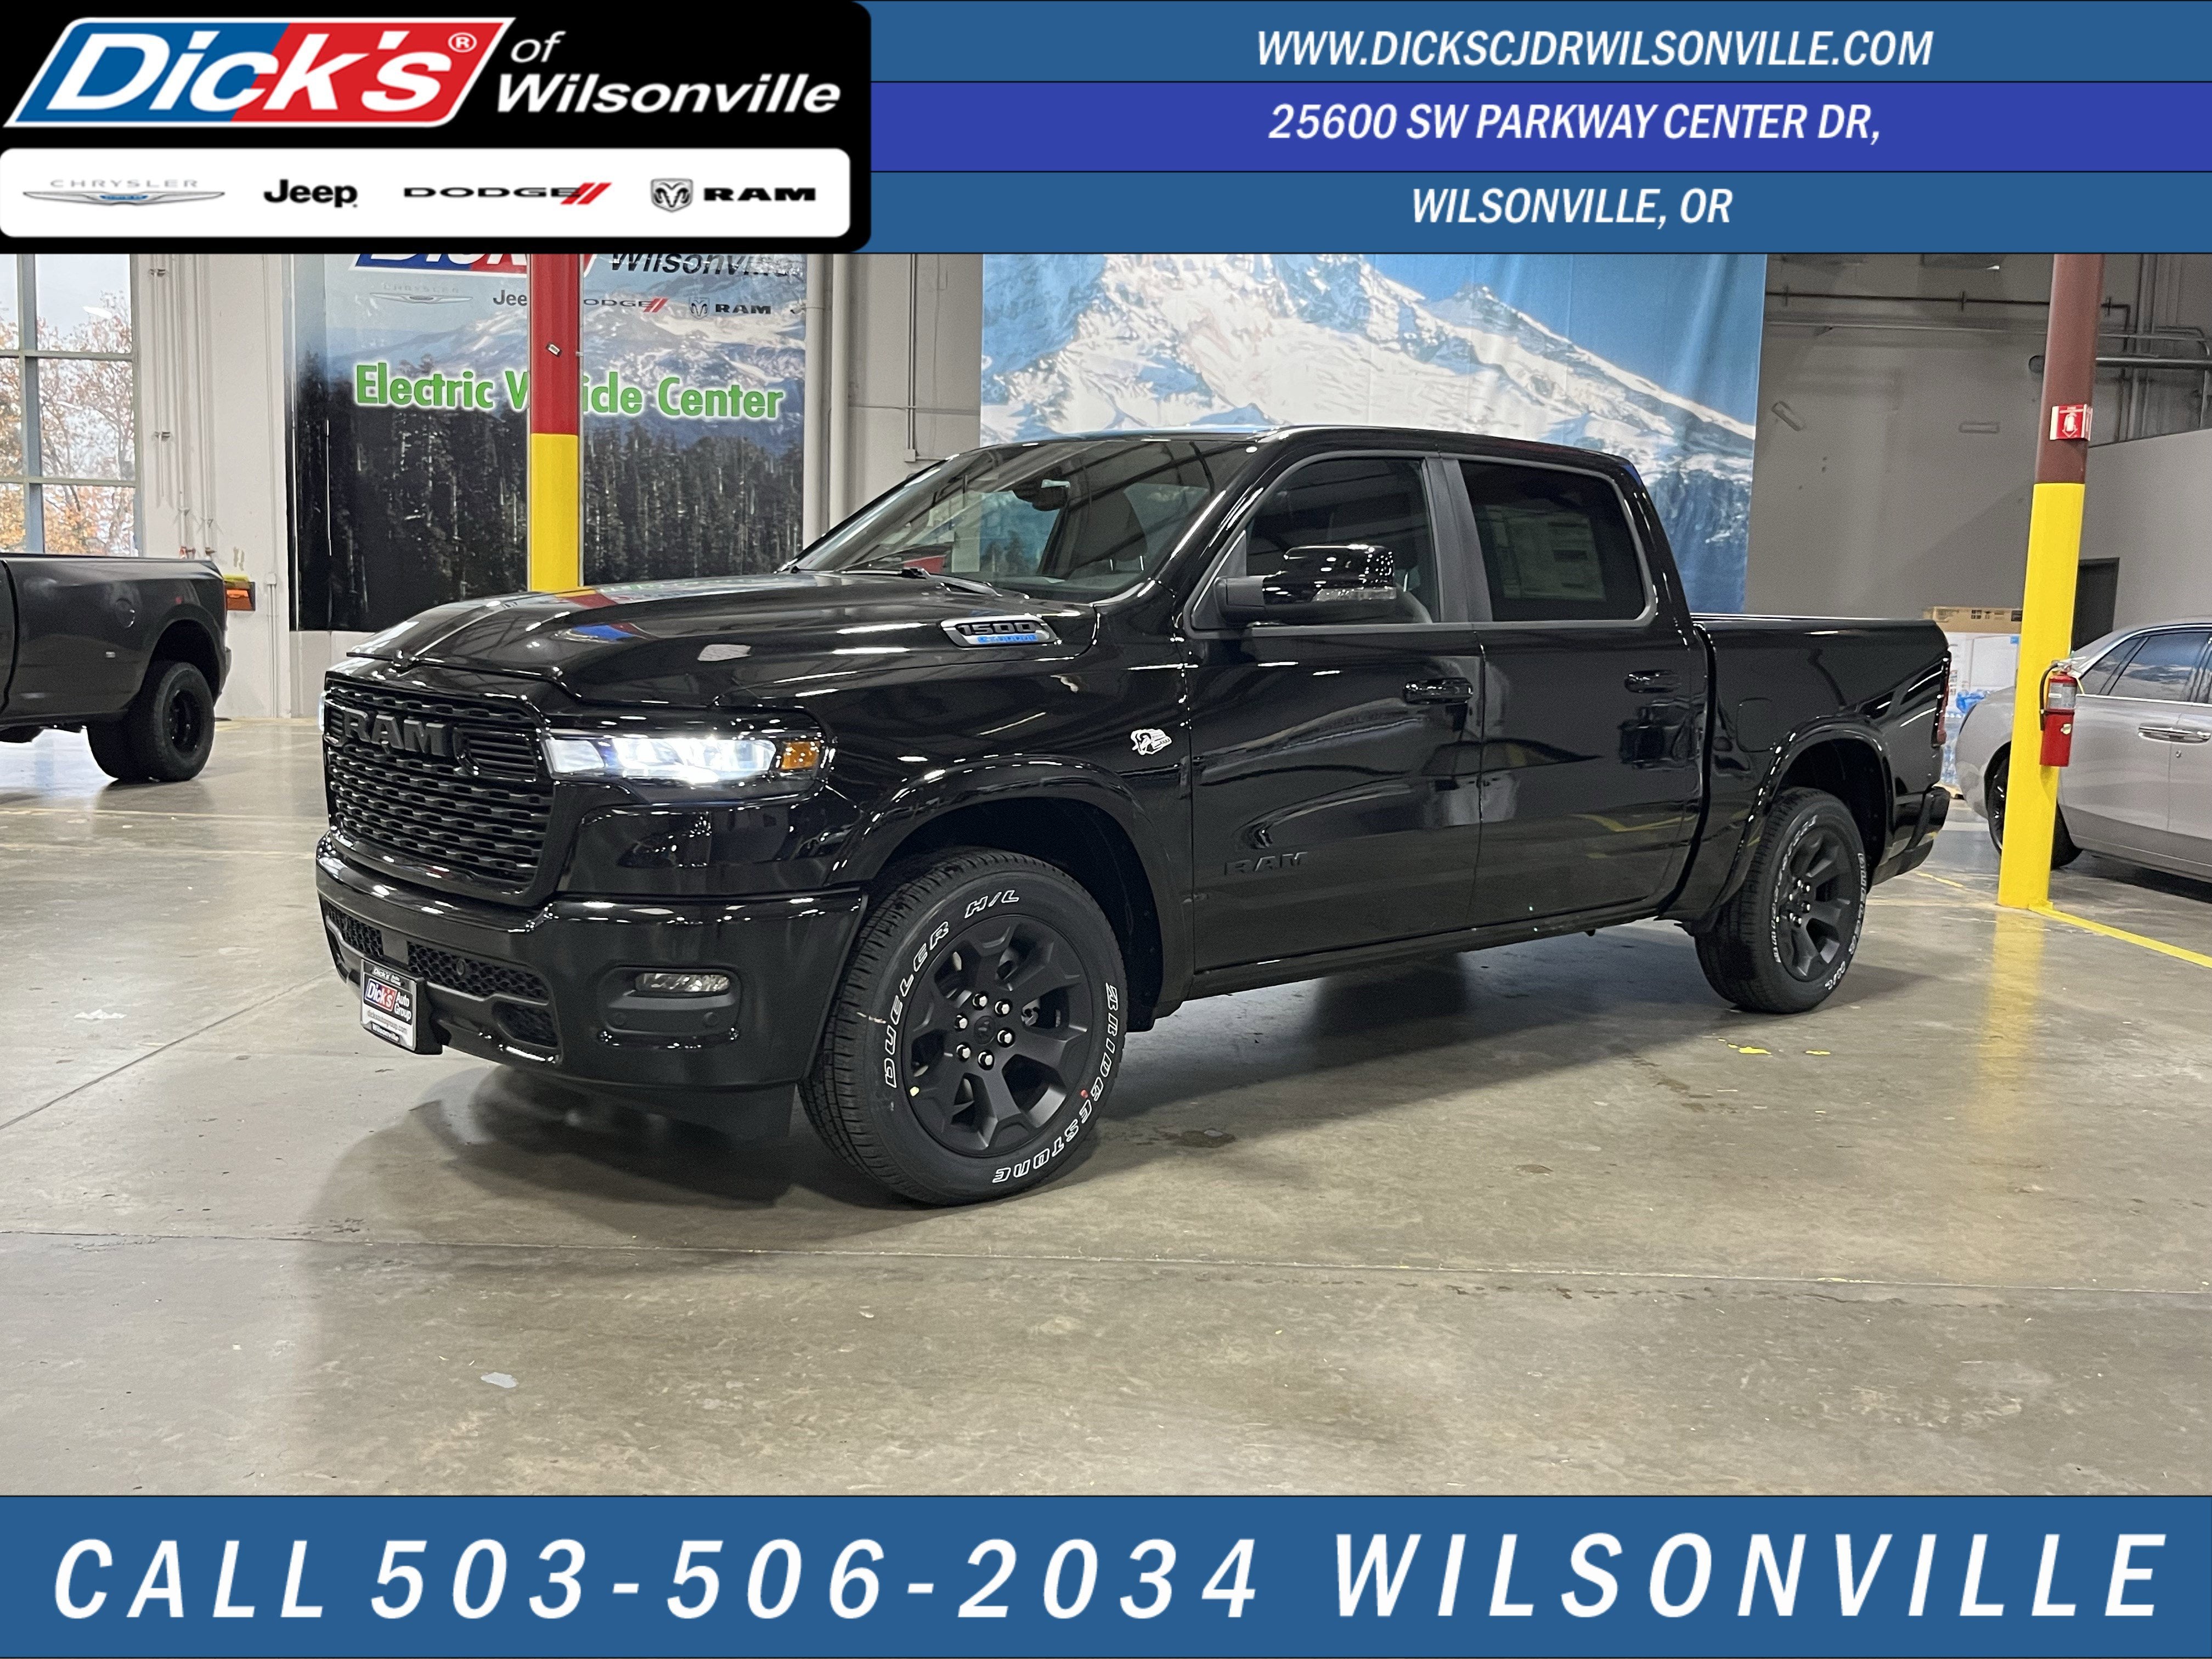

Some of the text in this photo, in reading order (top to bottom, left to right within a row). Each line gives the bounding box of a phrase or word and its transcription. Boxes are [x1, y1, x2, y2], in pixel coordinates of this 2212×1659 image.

[493, 289, 527, 306] Jee
[583, 298, 653, 308] ODGE
[715, 304, 771, 315] RAM
[356, 362, 494, 409] Electric
[661, 377, 785, 418] Center
[958, 622, 1039, 636] 1500
[344, 708, 447, 757] RAM
[964, 889, 1020, 918] H/L
[367, 981, 394, 1008] Dick's
[396, 991, 410, 1008] Auto
[394, 1003, 412, 1022] Group
[992, 983, 1119, 1183] BRIDGESTONE
